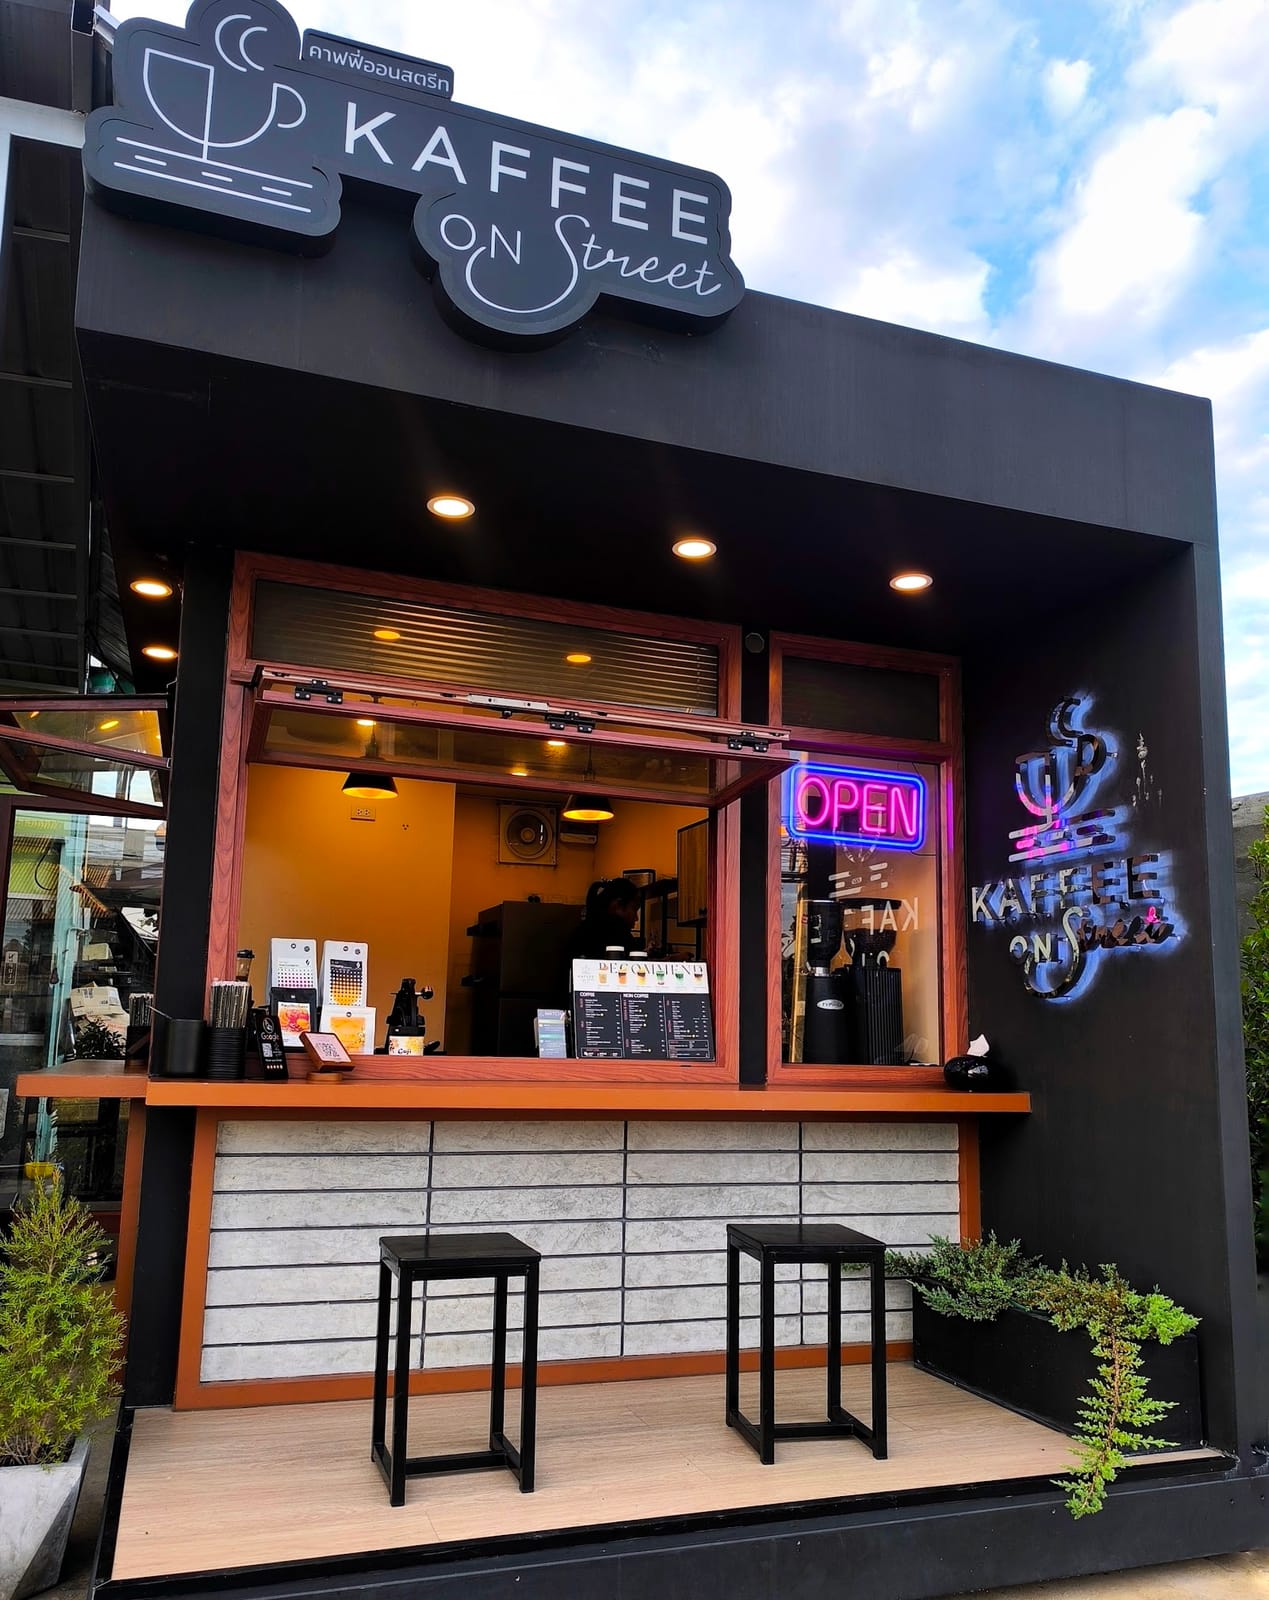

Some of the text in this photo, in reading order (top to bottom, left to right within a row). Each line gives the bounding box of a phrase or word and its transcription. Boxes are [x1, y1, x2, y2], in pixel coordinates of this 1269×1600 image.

[309, 44, 450, 92] คาฟฟี่ออนสตรีท
[345, 101, 710, 245] KAFFEE
[439, 213, 722, 314] ON Street
[796, 776, 919, 837] OPEN
[971, 852, 1160, 923] KAFFEE
[1009, 932, 1053, 963] ON
